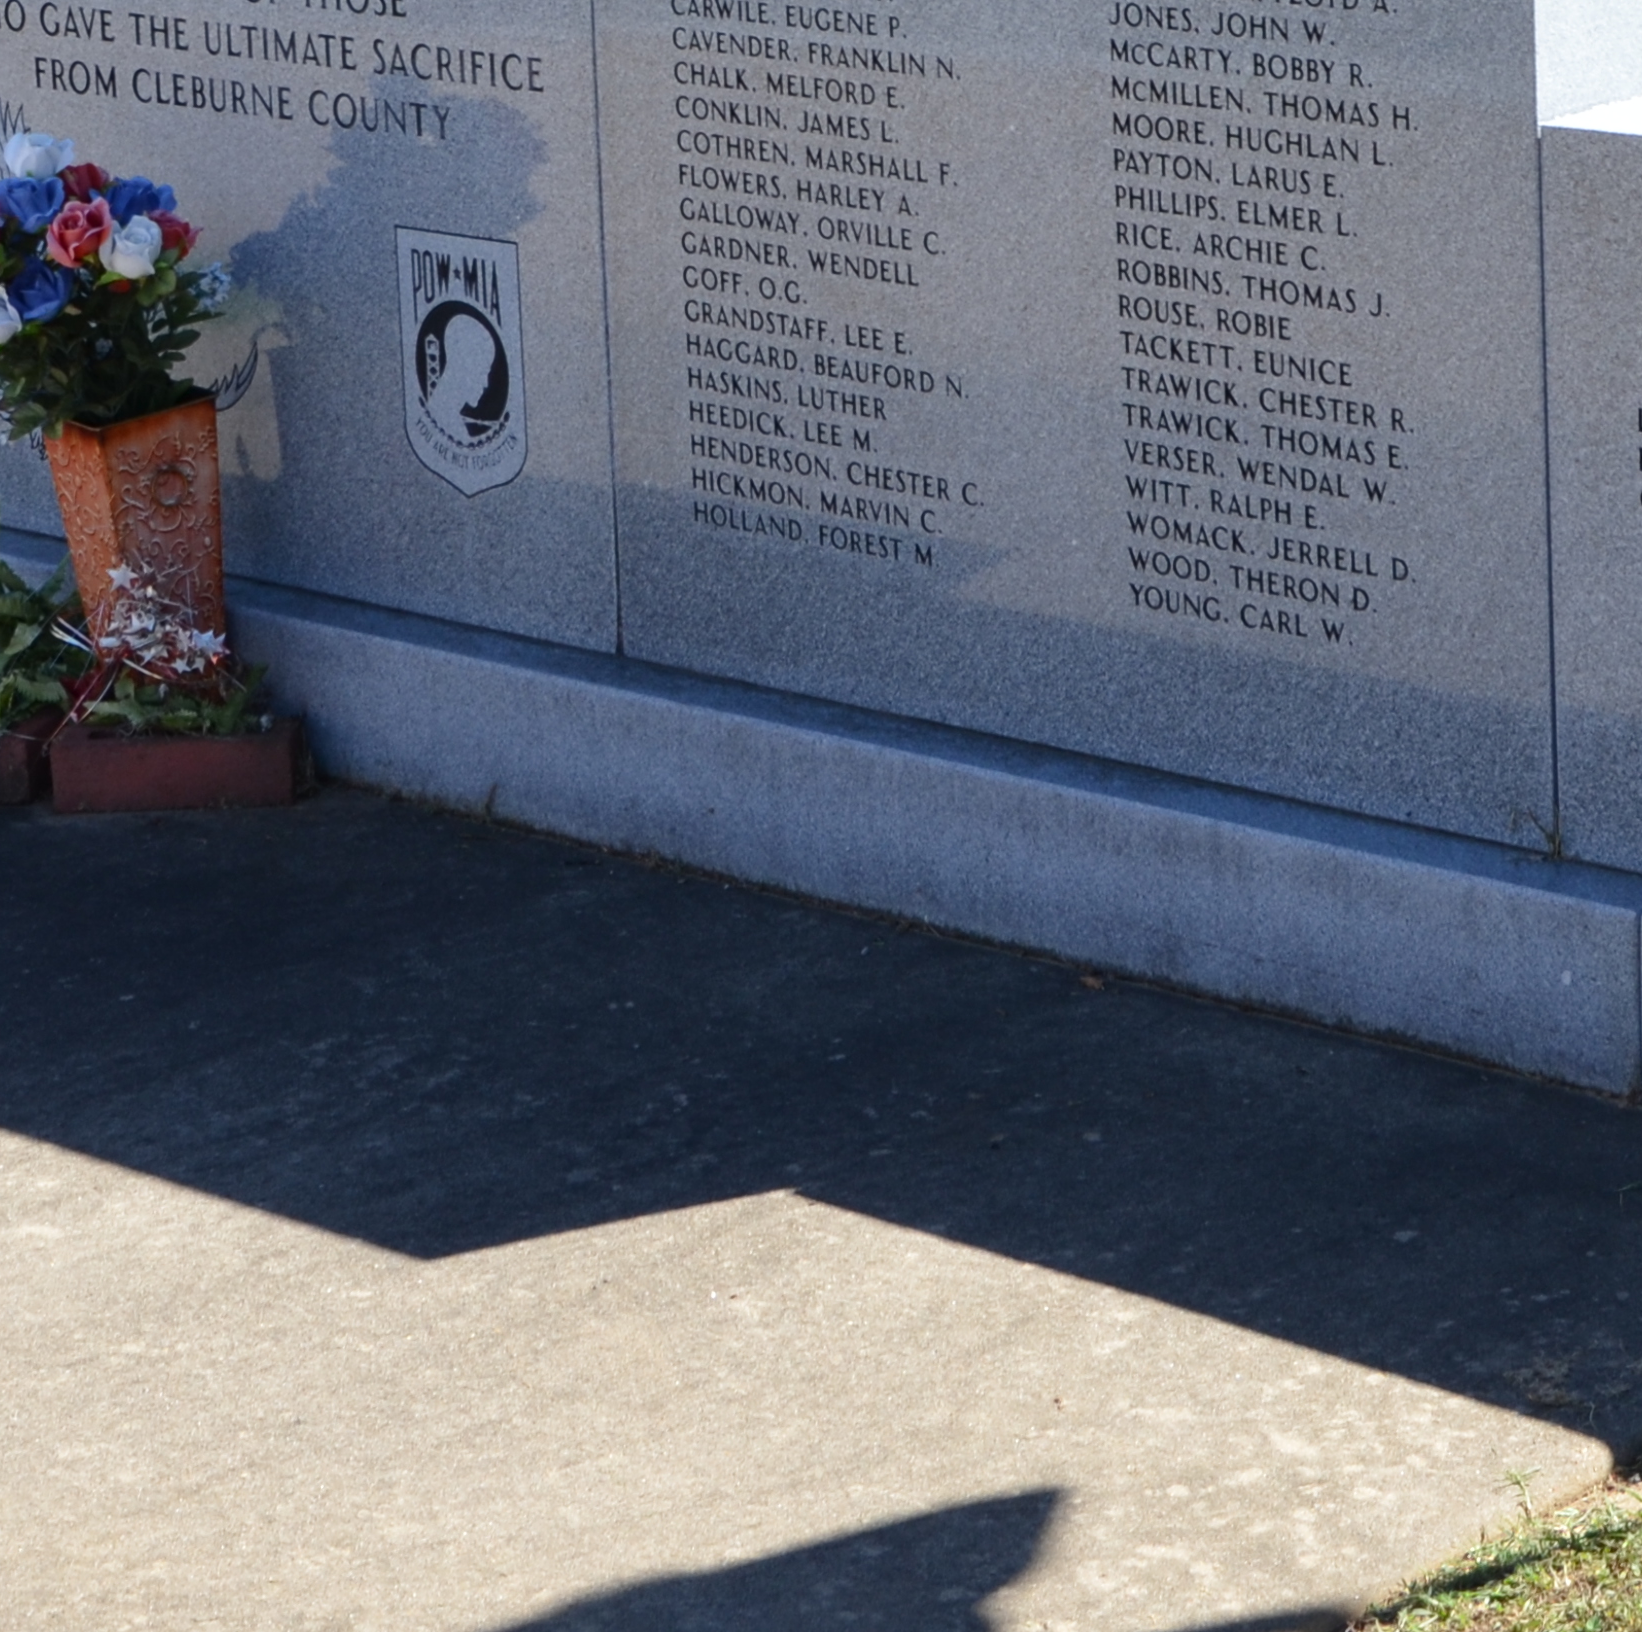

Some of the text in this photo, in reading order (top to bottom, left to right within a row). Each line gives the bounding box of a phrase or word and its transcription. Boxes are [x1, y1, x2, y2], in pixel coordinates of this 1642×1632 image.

[39, 3, 115, 43] GAVE
[128, 12, 189, 52] THE
[203, 21, 357, 71] ULTIMATE
[372, 38, 545, 93] SACRIFICE
[807, 41, 925, 76] FRANKLIN
[1252, 52, 1334, 83] BOBBY
[33, 57, 452, 140] FROM CLEBURNE COUNTY
[1225, 124, 1358, 162] HUGHLAN
[805, 145, 927, 183] MARSHALL
[1193, 233, 1287, 265] ARCHIE
[814, 353, 934, 393] BEAUFORD
[1260, 424, 1375, 465] THOMAS
